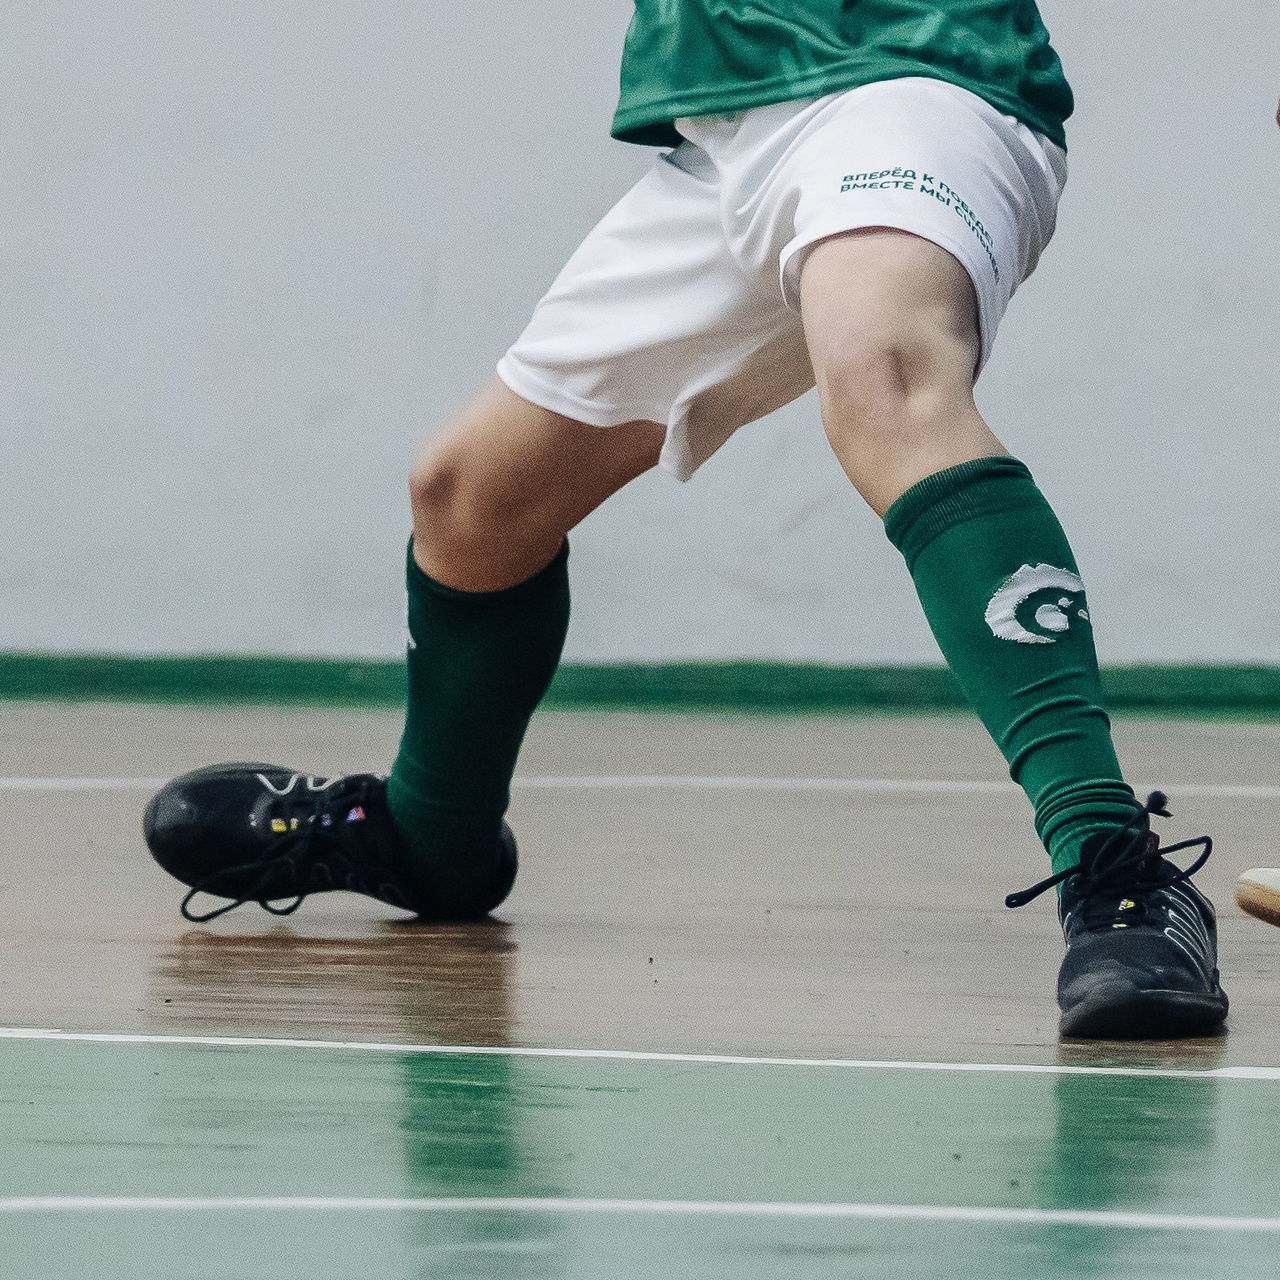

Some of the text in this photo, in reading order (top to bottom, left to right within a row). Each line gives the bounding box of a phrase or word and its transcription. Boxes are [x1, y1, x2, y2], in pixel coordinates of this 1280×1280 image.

[842, 167, 917, 182] ВПЕРЁД
[923, 173, 935, 185] К
[840, 180, 915, 193] ВМЕСТЕ
[919, 184, 951, 206] МЫ
